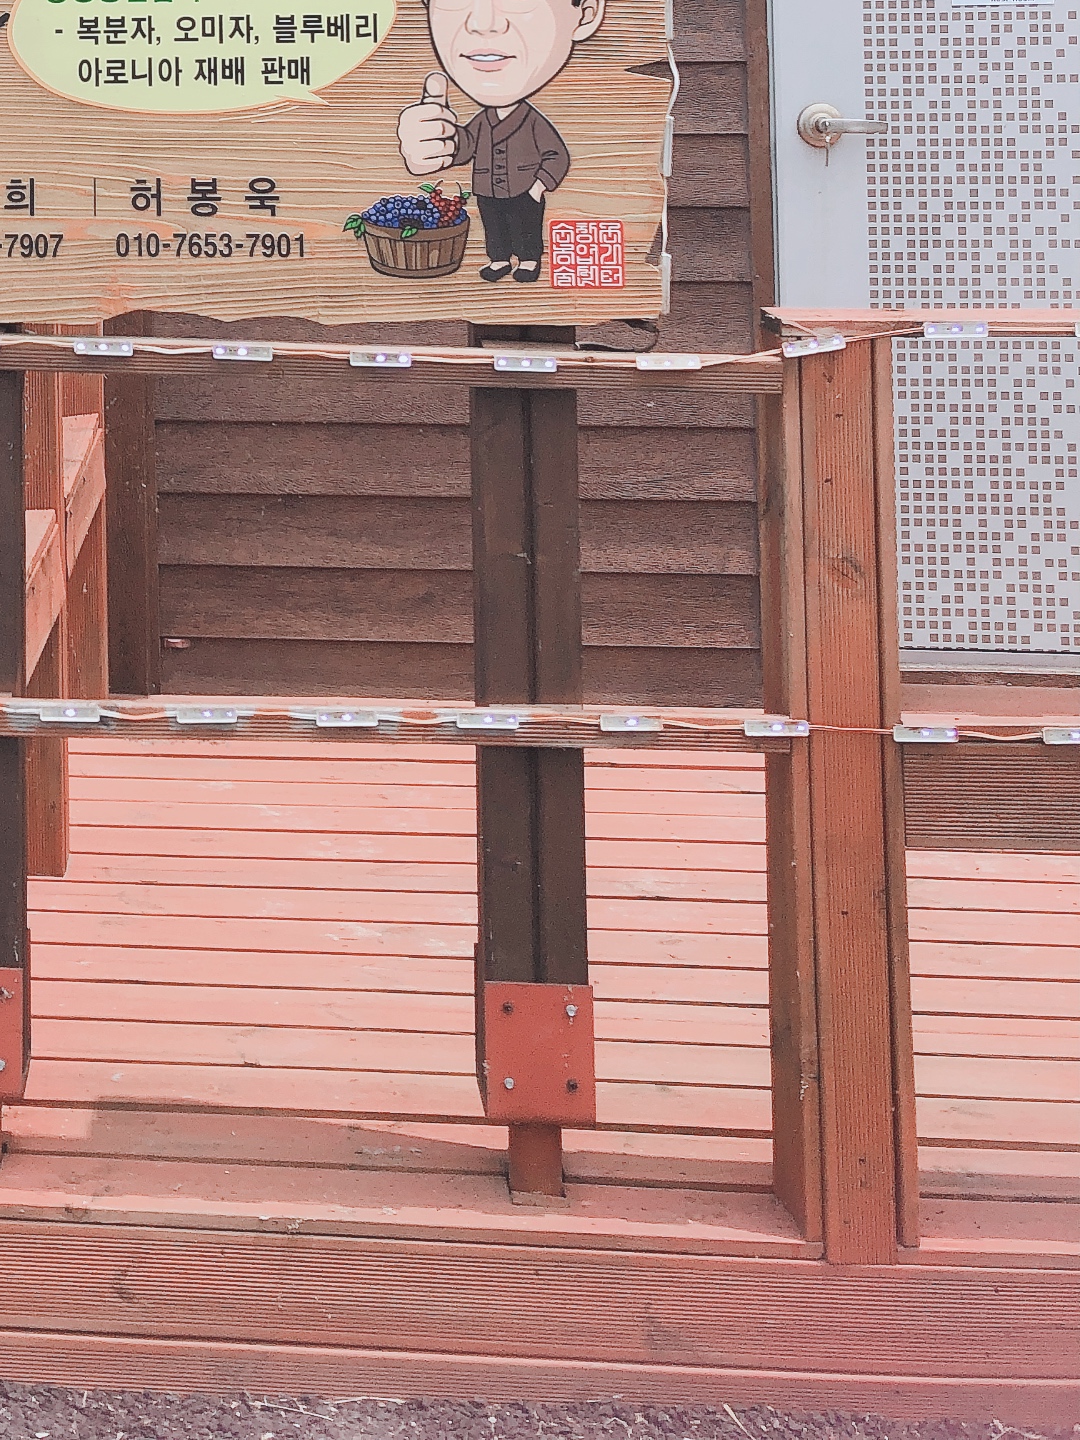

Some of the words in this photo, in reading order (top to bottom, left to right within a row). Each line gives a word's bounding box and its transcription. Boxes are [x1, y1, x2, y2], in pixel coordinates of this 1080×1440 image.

[76, 16, 161, 46] 복분자,
[173, 16, 260, 46] 오미자,
[272, 13, 379, 44] 블루베리
[78, 57, 183, 87] 아로니아
[194, 56, 246, 86] 재배
[260, 56, 311, 86] 판매
[115, 232, 306, 258] 010-7653-7901
